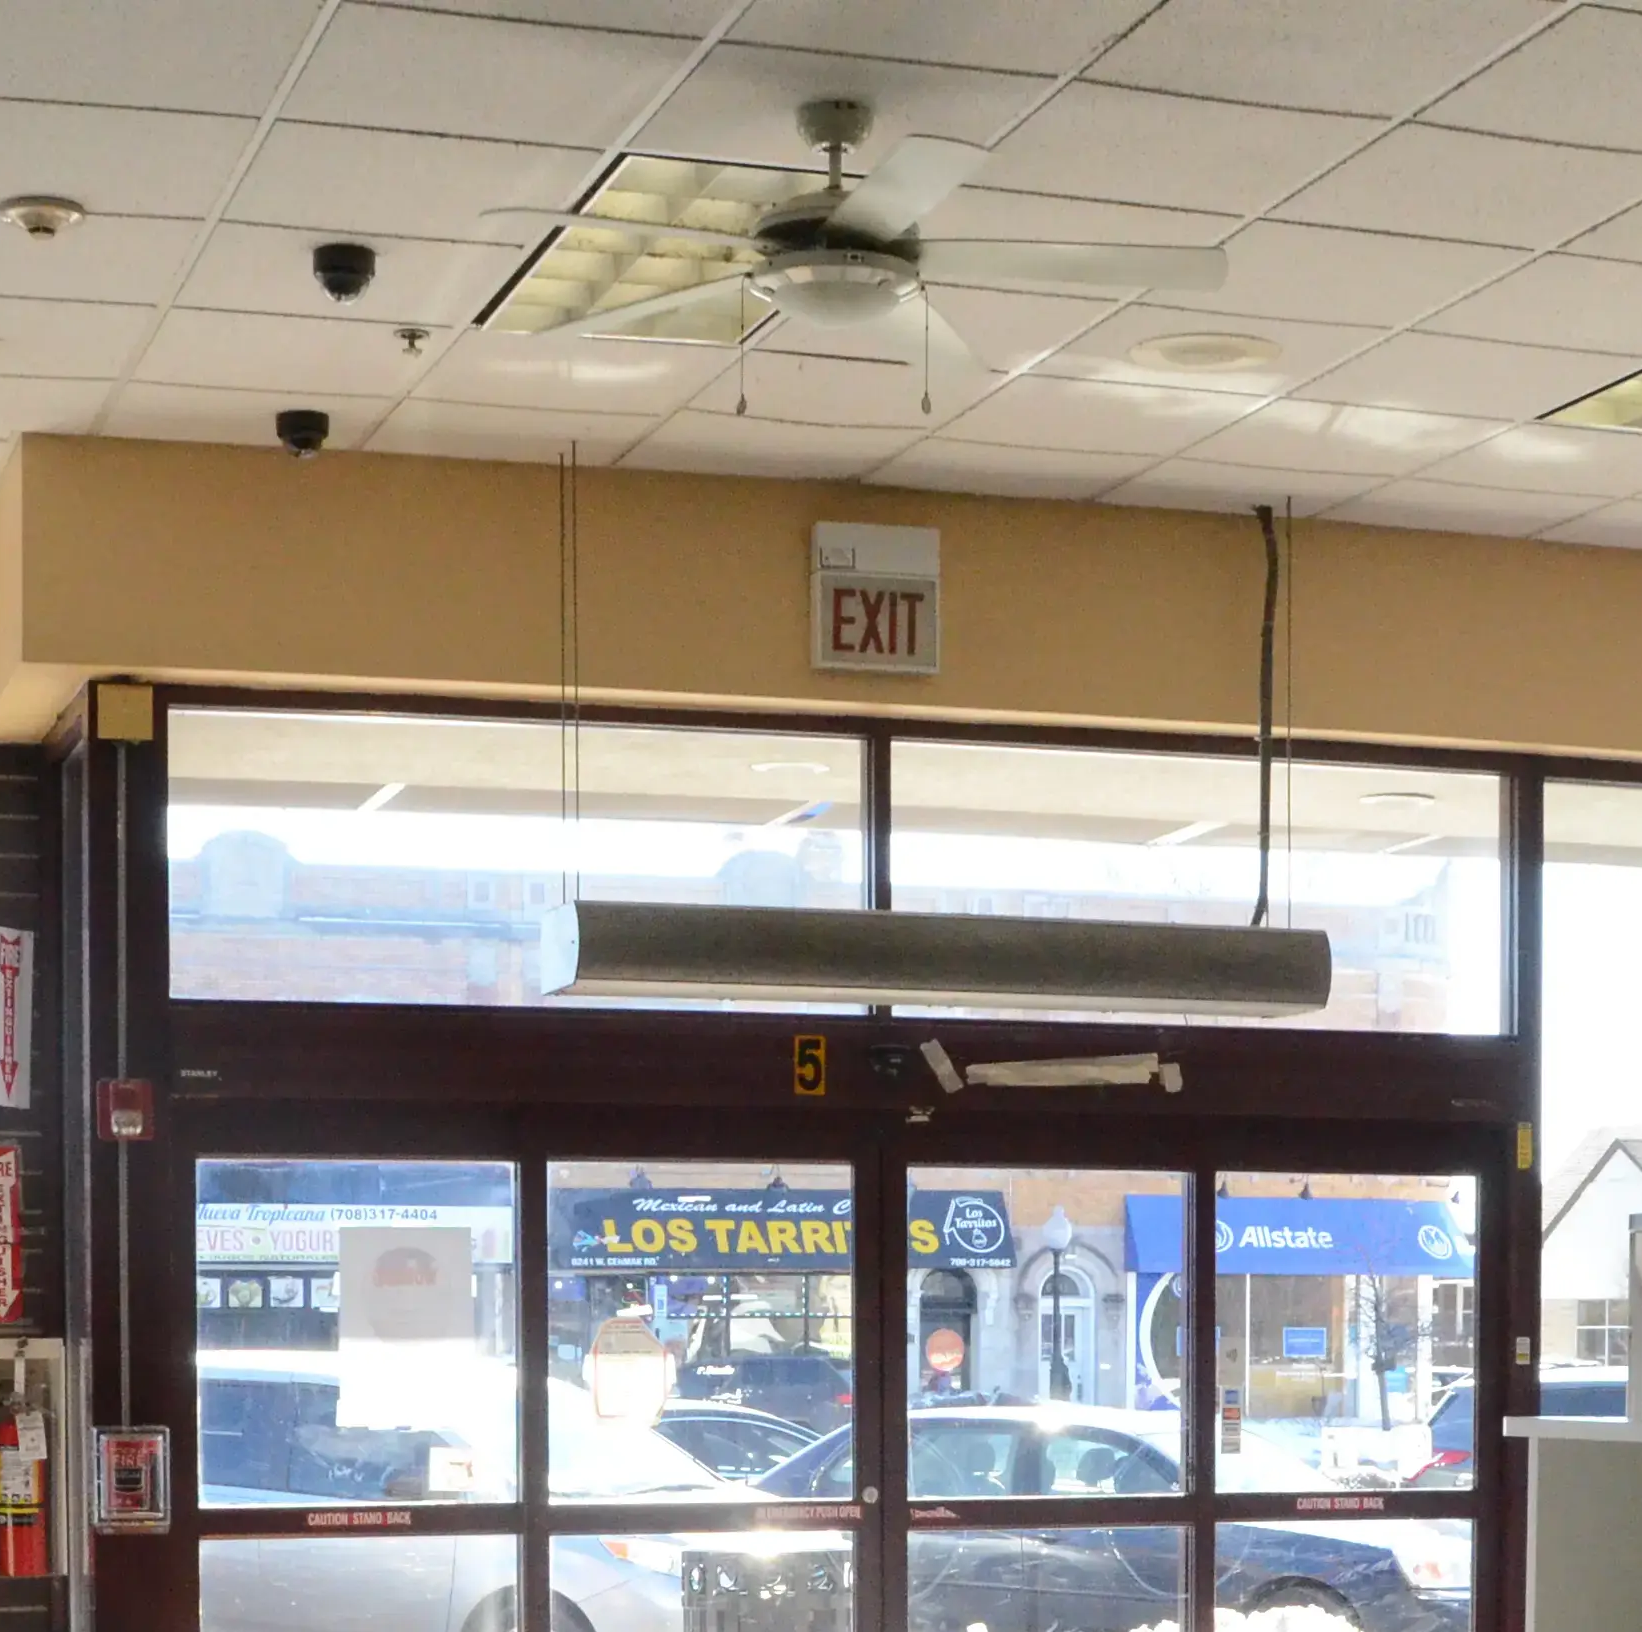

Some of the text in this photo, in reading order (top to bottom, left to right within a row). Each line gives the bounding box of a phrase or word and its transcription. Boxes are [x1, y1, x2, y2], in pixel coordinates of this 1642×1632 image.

[832, 588, 925, 656] EXIT
[0, 943, 21, 967] FIRE
[797, 1038, 823, 1091] 5
[245, 1203, 325, 1226] Tropicana
[330, 1207, 439, 1221] (708)317-4404
[632, 1196, 718, 1213] Mexican
[725, 1199, 763, 1213] and
[766, 1199, 825, 1213] Latin
[965, 1207, 983, 1219] Los
[269, 1229, 341, 1252] YOGUR
[602, 1217, 699, 1254] LOS
[1238, 1225, 1335, 1249] Allstate
[839, 1506, 862, 1519] OPEN
[1296, 1497, 1385, 1510] CAUTION STAND BACK
[307, 1511, 412, 1526] CAUTION STAND BACK
